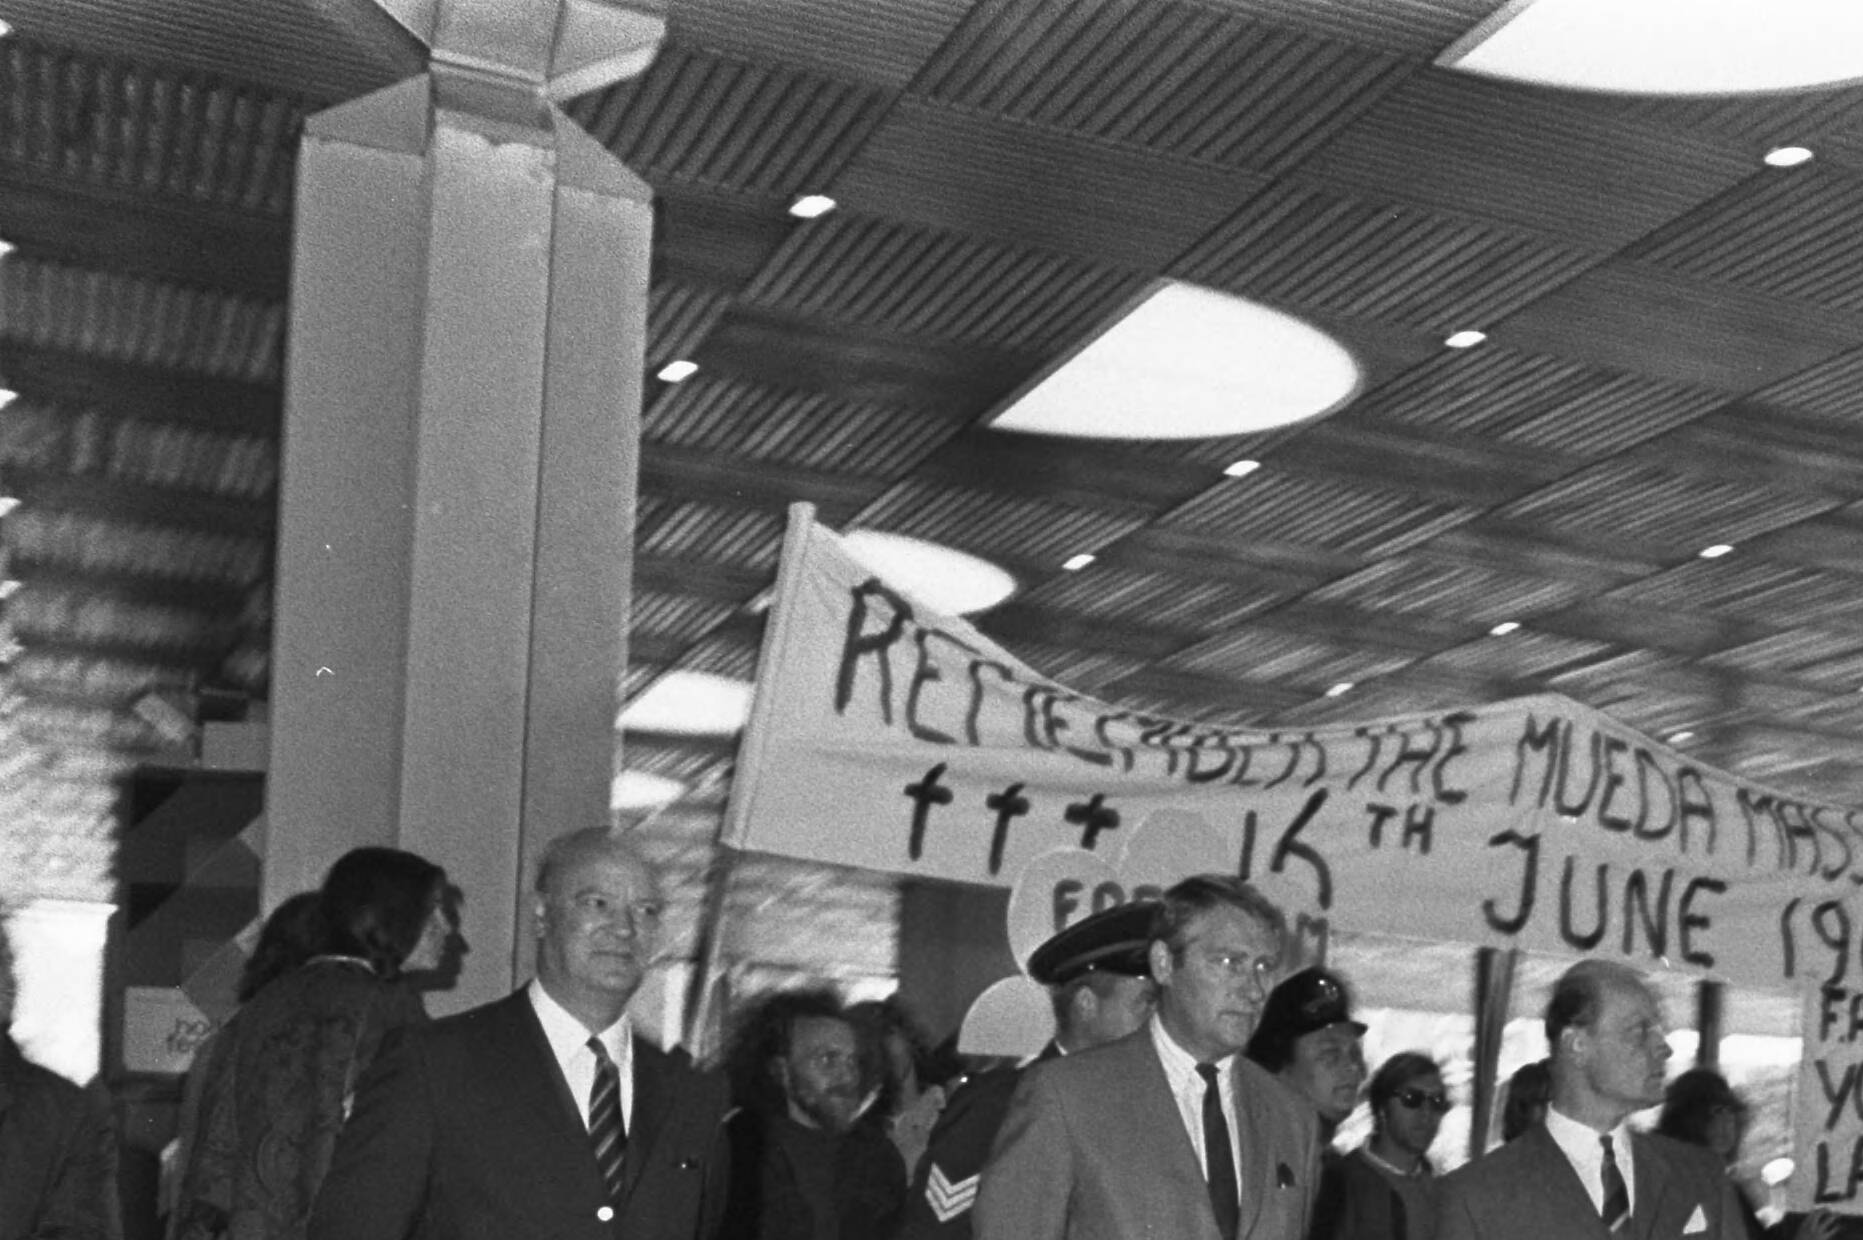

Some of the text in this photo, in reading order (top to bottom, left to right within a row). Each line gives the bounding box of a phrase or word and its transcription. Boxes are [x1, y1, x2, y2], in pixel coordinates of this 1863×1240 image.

[1348, 711, 1476, 804] THE
[1509, 712, 1716, 855] MUEDA
[1482, 828, 1728, 969] JUNE
